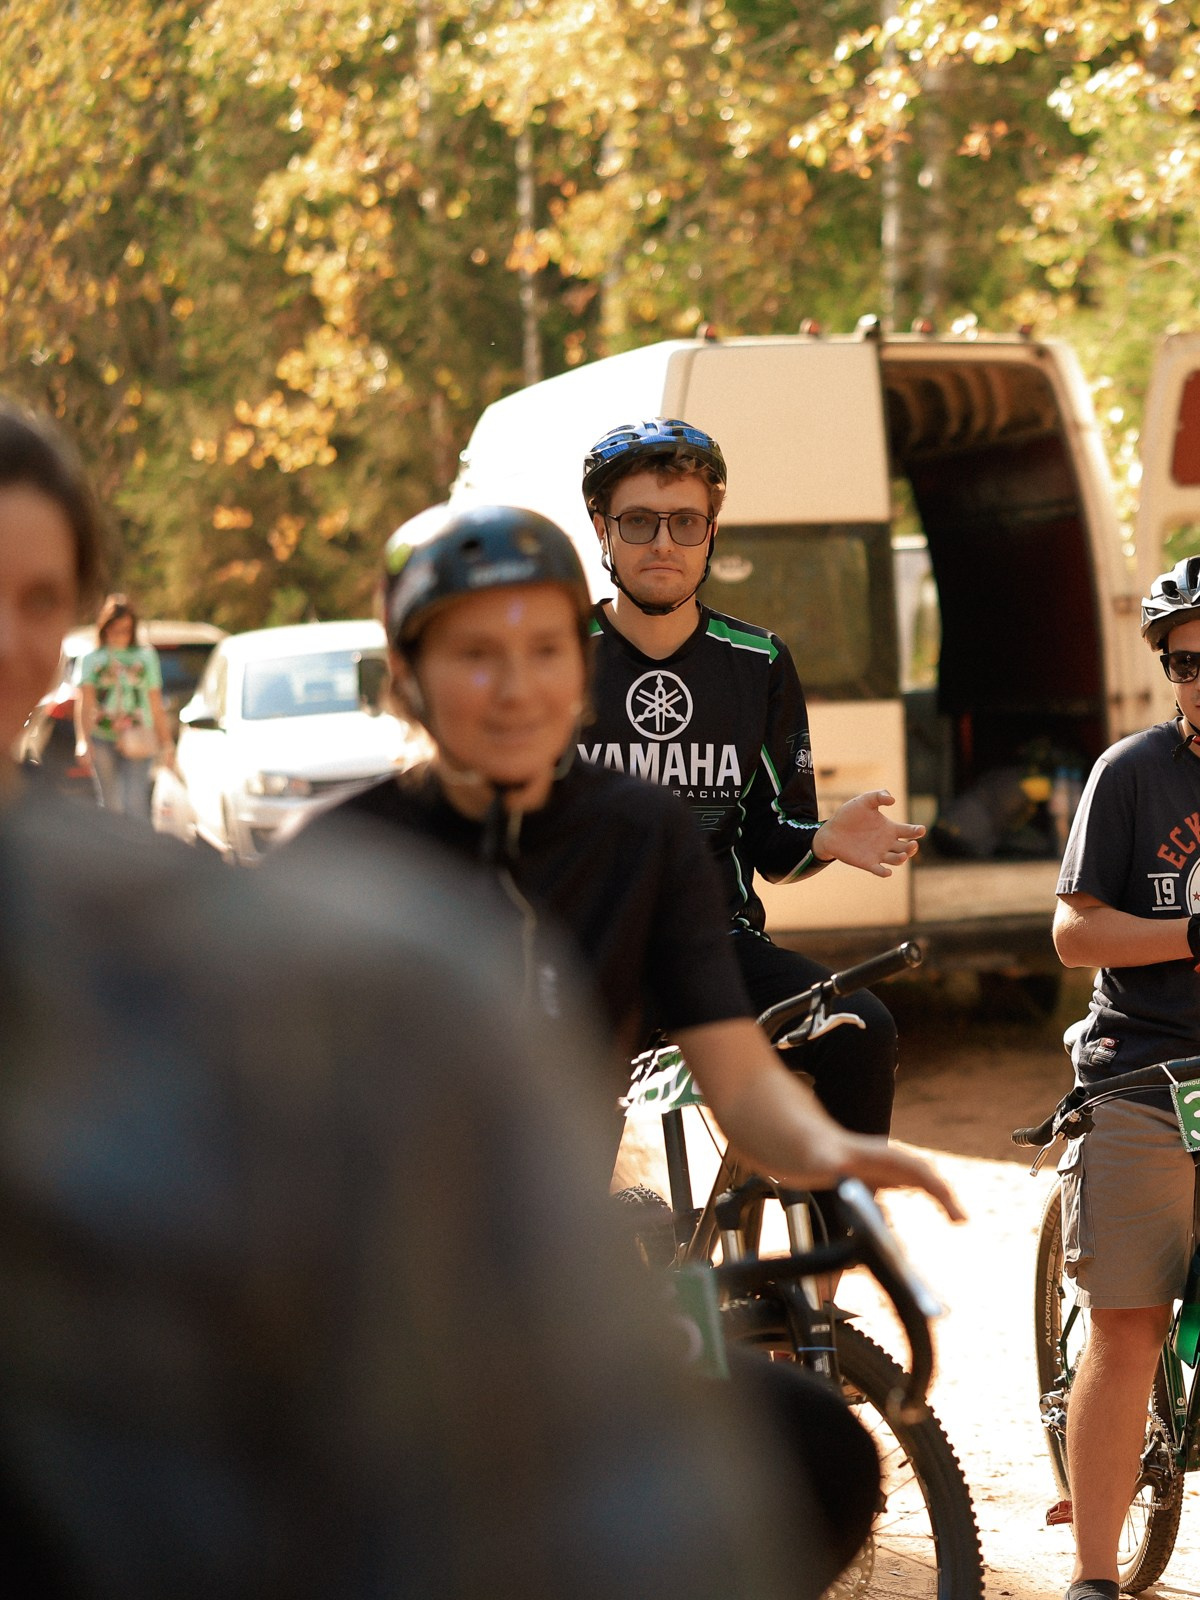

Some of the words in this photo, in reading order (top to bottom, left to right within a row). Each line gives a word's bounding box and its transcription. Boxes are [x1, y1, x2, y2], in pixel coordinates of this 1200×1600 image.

[576, 742, 742, 787] YAMAHA
[1153, 877, 1175, 906] 19
[1044, 1281, 1053, 1346] ALEXRIMS
